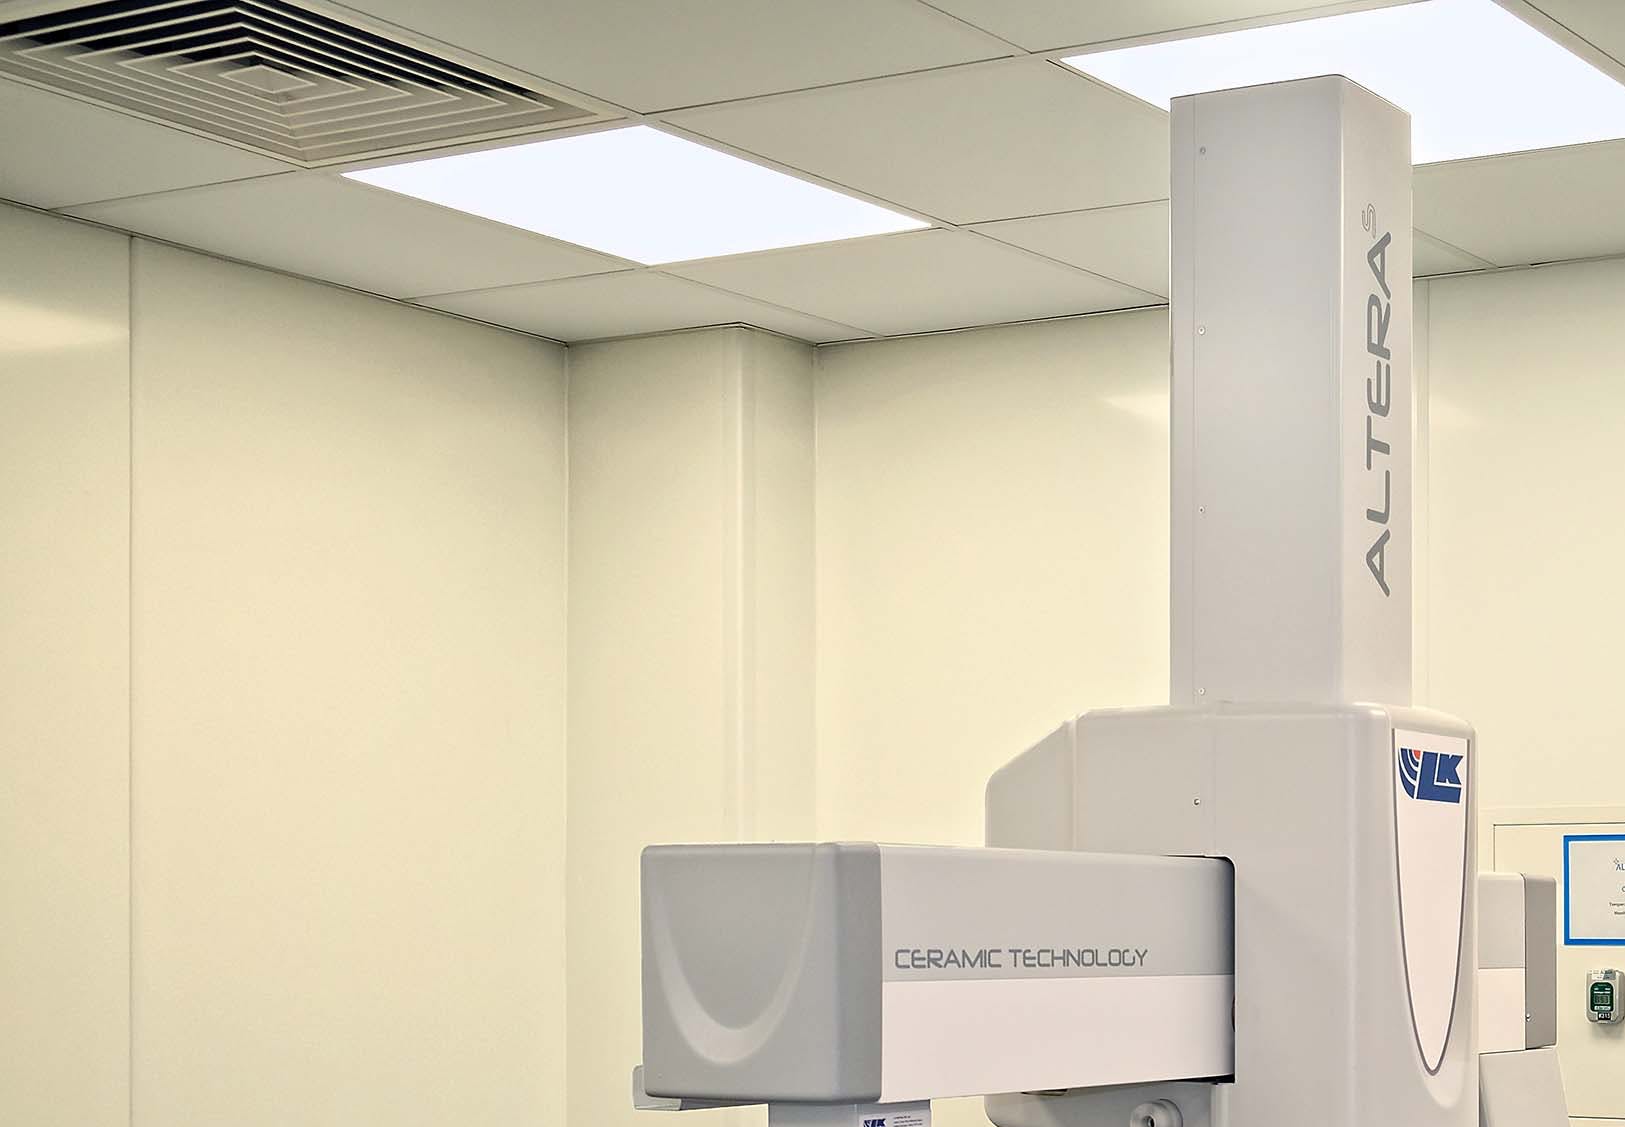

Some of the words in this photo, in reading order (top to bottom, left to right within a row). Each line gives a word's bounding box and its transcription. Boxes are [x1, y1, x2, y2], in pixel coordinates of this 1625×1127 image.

[1416, 750, 1464, 804] LK
[895, 949, 1002, 969] CERAMIC
[1008, 949, 1148, 968] TECHNOLOGY
